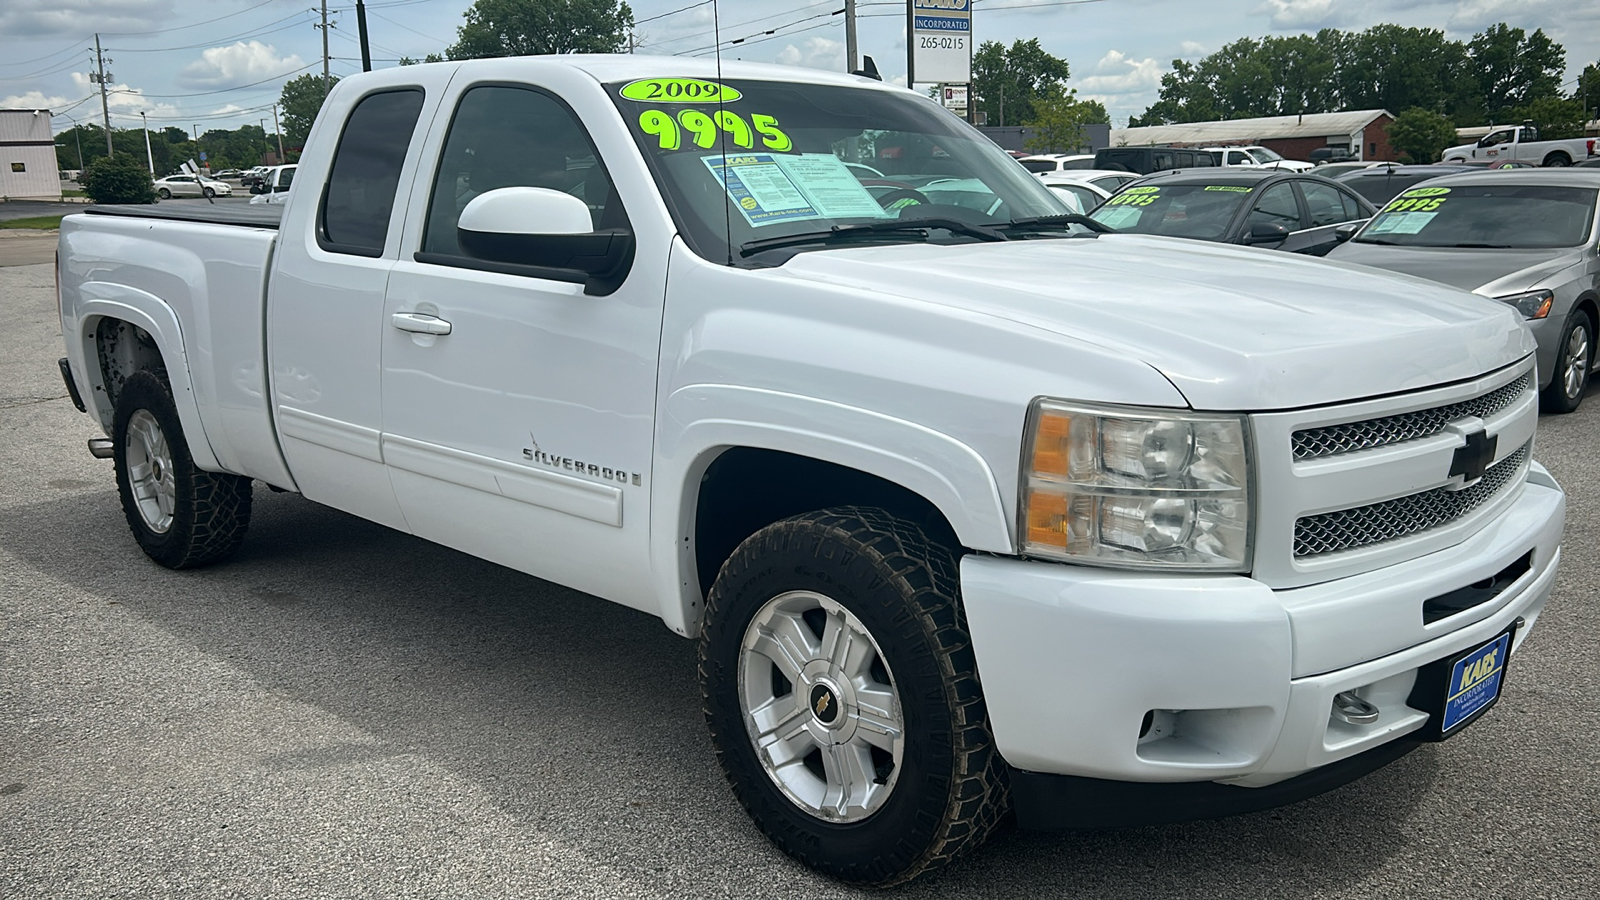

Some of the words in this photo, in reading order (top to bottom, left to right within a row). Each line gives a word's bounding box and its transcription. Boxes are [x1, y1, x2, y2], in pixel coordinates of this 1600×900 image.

[916, 19, 968, 29] INCORPORATED
[921, 37, 964, 49] 265-0215
[646, 82, 719, 99] 2009
[639, 109, 793, 152] 9995
[725, 156, 758, 165] KARS
[1384, 198, 1447, 213] 9995
[522, 448, 628, 483] SILVERADO
[1459, 648, 1498, 691] KARS
[1453, 675, 1495, 708] INCORPORATED
